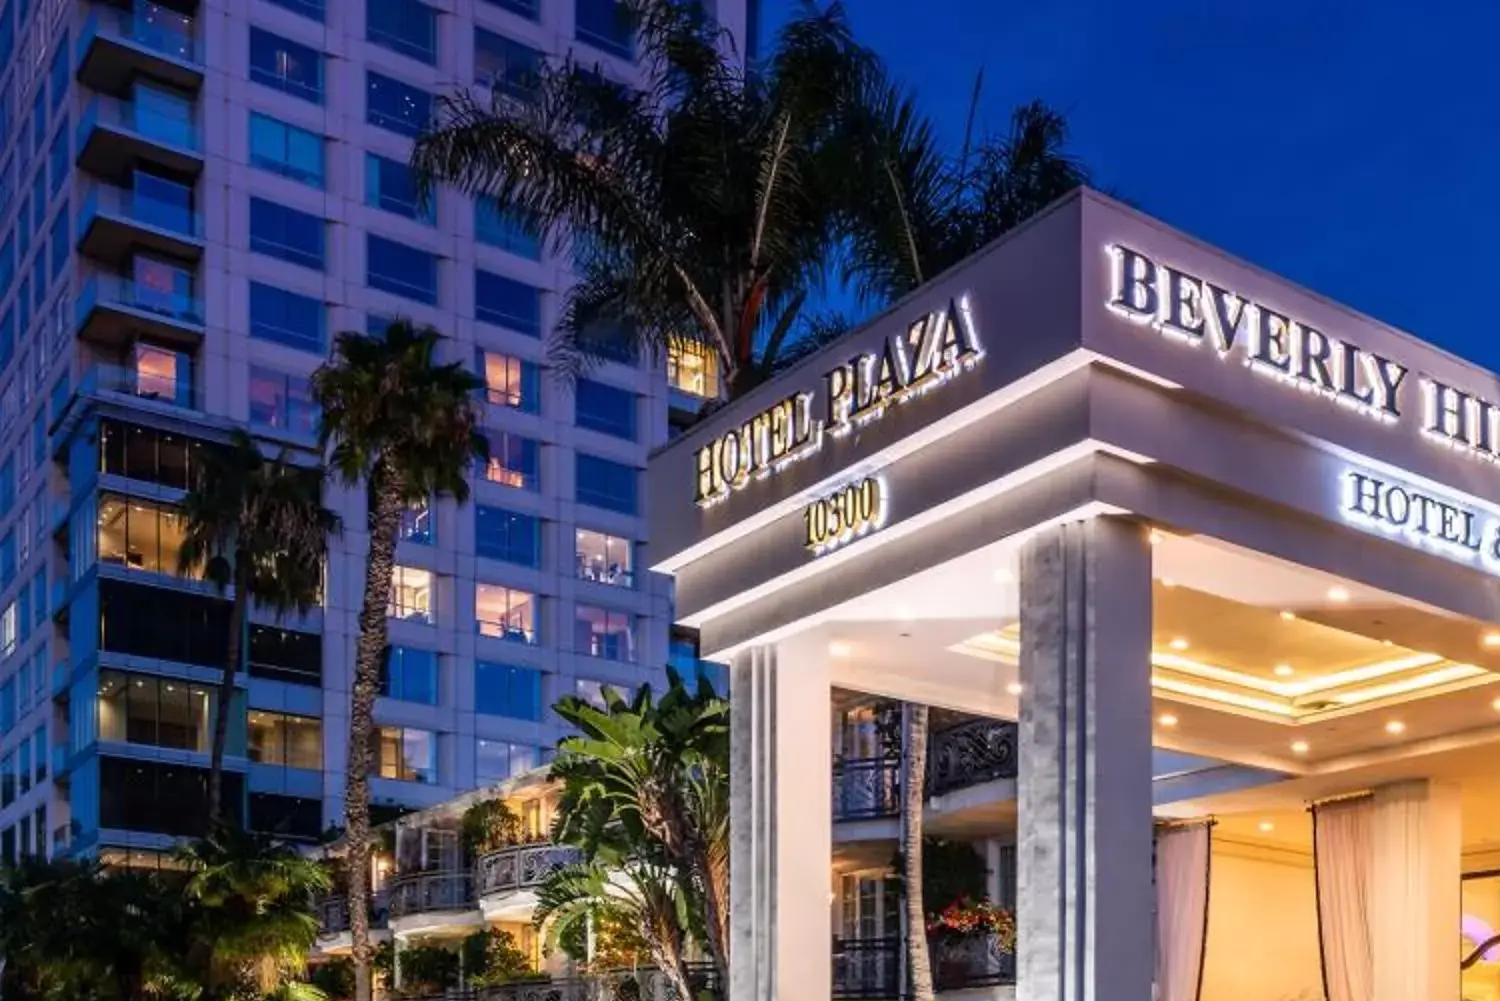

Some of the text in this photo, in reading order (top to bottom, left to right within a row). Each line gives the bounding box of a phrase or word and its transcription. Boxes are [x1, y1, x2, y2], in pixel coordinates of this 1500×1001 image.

[695, 297, 982, 502] HOTEL PLAZA
[1108, 244, 1408, 416] BEVERLY
[1348, 473, 1482, 550] HOTEL
